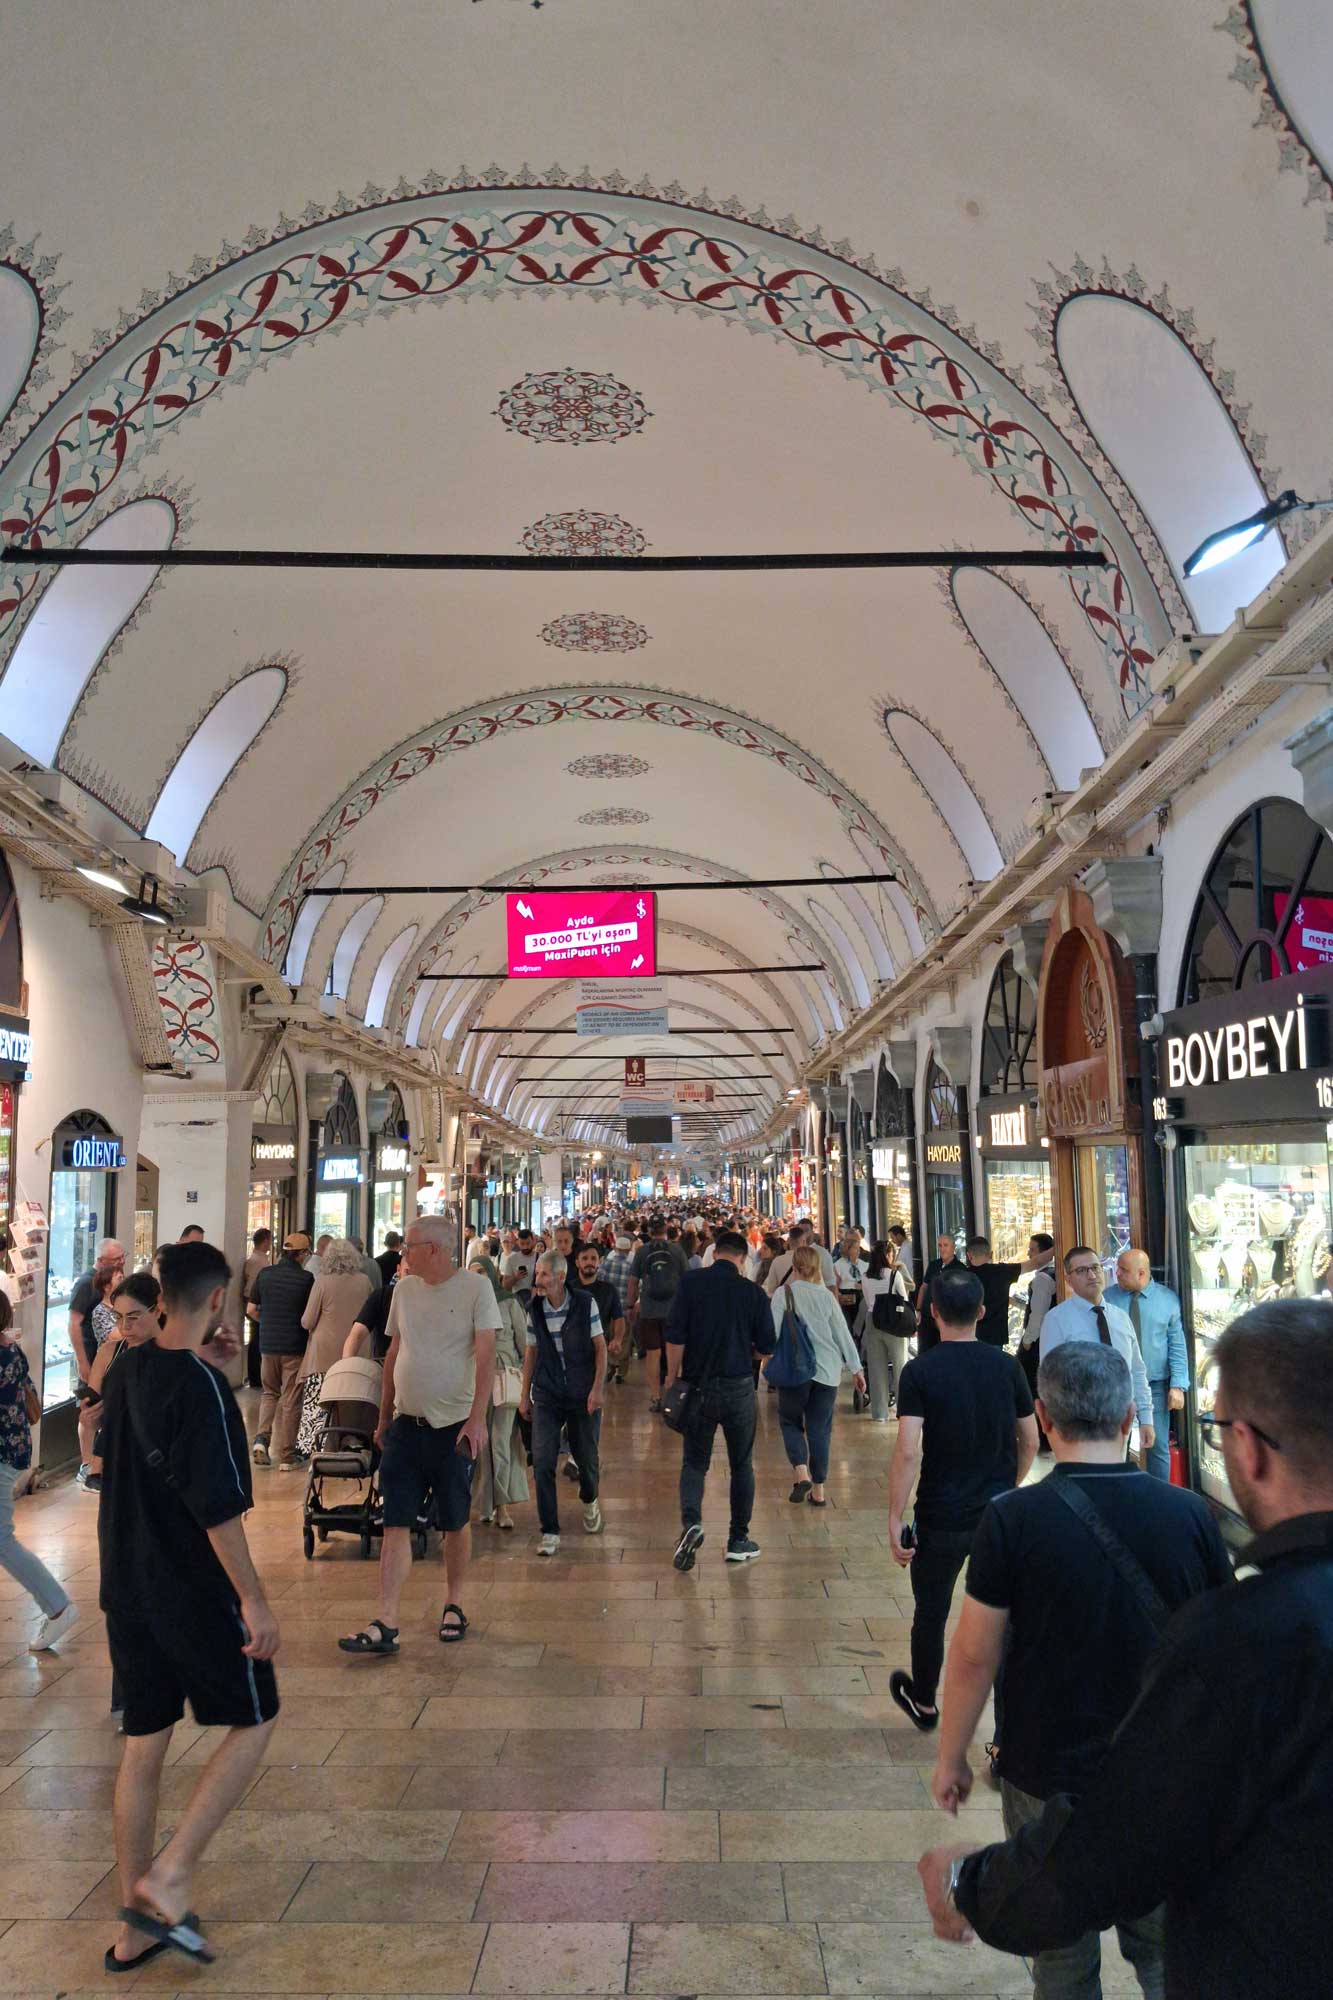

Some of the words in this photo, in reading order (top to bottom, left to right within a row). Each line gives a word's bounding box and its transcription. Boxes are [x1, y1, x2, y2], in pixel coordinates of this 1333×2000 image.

[566, 915, 594, 928] Ayda
[532, 933, 573, 947] 30.000
[576, 929, 602, 942] TL'yi
[605, 928, 631, 940] aşan
[544, 947, 598, 962] MaxiPuan
[601, 943, 621, 957] için
[1167, 992, 1307, 1088] BOYBEYİ
[626, 1072, 644, 1082] WC
[1316, 1077, 1333, 1108] 16
[1153, 1096, 1167, 1120] 163
[990, 1104, 1028, 1146] HAYRİ
[72, 1134, 120, 1167] ORİENT
[256, 1144, 295, 1159] HAYDAR
[927, 1145, 961, 1162] HAYDAR
